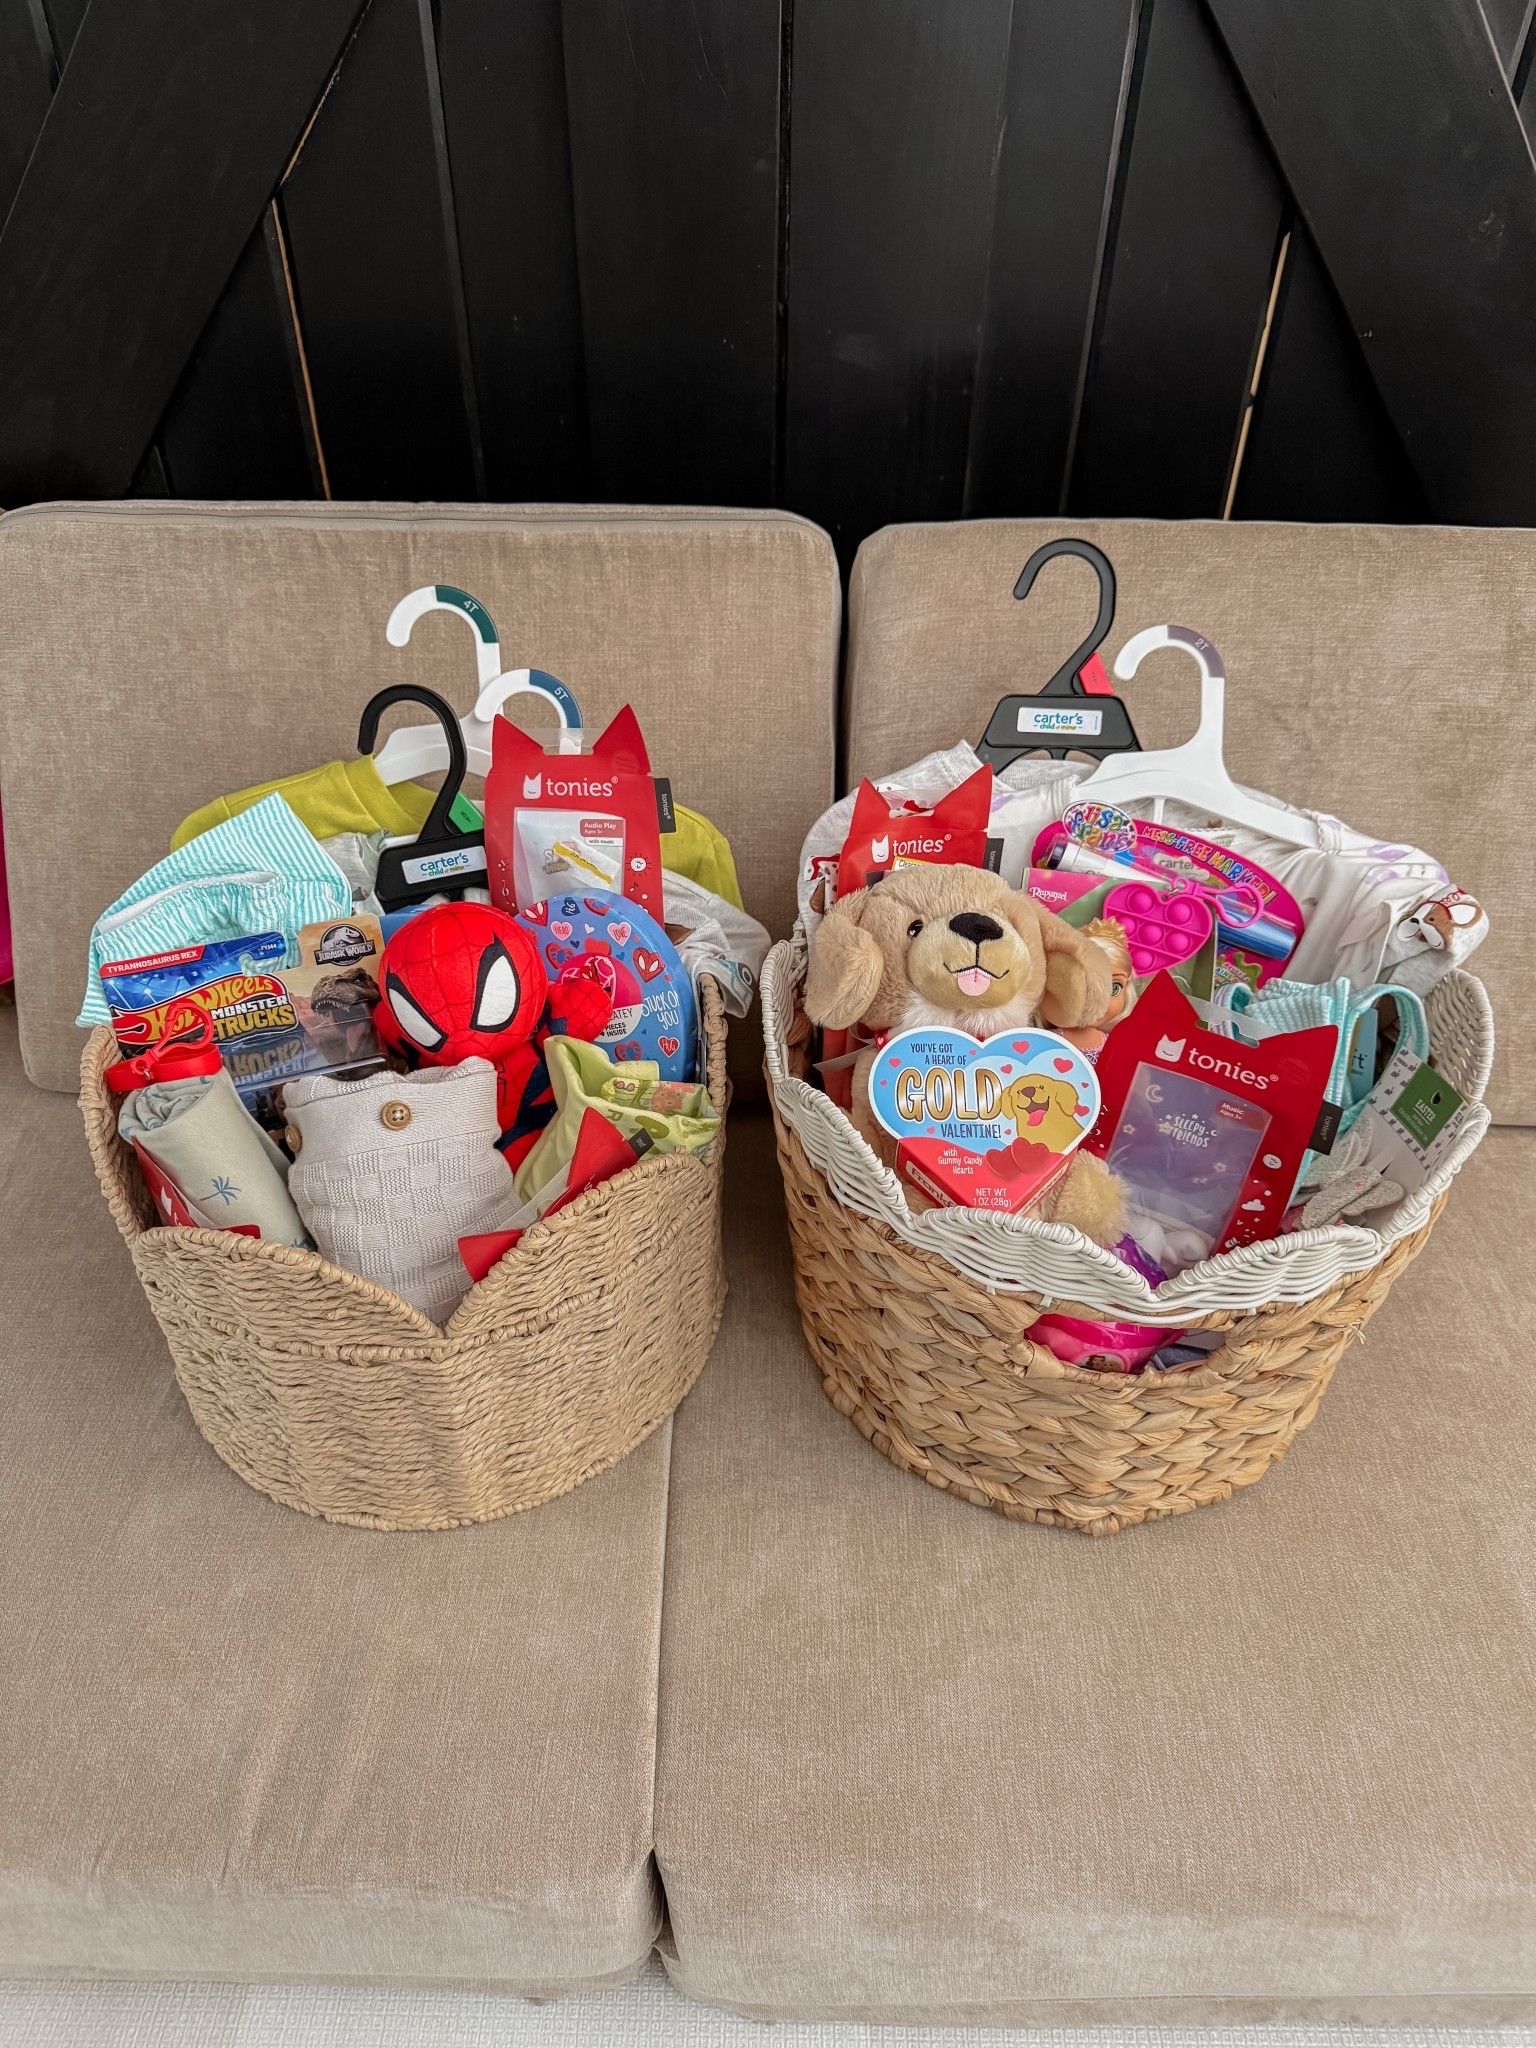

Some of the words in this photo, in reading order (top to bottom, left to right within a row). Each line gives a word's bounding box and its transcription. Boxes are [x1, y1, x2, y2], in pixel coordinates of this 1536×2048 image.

[463, 600, 479, 613] 4T
[1195, 639, 1209, 651] 2T
[554, 686, 568, 700] 5T
[1034, 712, 1083, 725] carter's
[546, 777, 613, 797] tonies
[892, 834, 944, 857] tonies
[1142, 826, 1213, 862] MESS-FREE
[421, 853, 469, 872] carter's
[345, 944, 373, 957] WORLD
[106, 954, 180, 973] TYRANNOSAURUS
[181, 950, 198, 959] REX
[211, 995, 288, 1019] MONSTER
[642, 991, 671, 1017] STUCK
[213, 1005, 295, 1040] TRUCKS
[605, 1022, 626, 1031] PIECES
[657, 1009, 679, 1030] YOU
[606, 1029, 627, 1037] INSIDE
[662, 1039, 676, 1051] HUG
[910, 1043, 938, 1054] YOU'VE
[939, 1043, 953, 1053] GOT
[932, 1056, 954, 1066] HEART
[957, 1055, 967, 1065] OF
[1189, 1047, 1269, 1090] tonies
[897, 1068, 1003, 1122] GOLD
[1221, 1103, 1244, 1115] Music
[1414, 1098, 1437, 1122] EASTER
[941, 1124, 1001, 1139] VALENTINE!
[1173, 1116, 1206, 1136] SLEEPY
[1172, 1127, 1210, 1148] FRIENDS
[943, 1149, 958, 1157] with
[938, 1156, 961, 1165] Gummy
[963, 1156, 983, 1165] Candy
[952, 1166, 974, 1175] Hearts
[976, 1188, 991, 1196] NET
[994, 1188, 1007, 1196] WT
[978, 1198, 989, 1206] OZ
[991, 1198, 1012, 1208] (28g)
